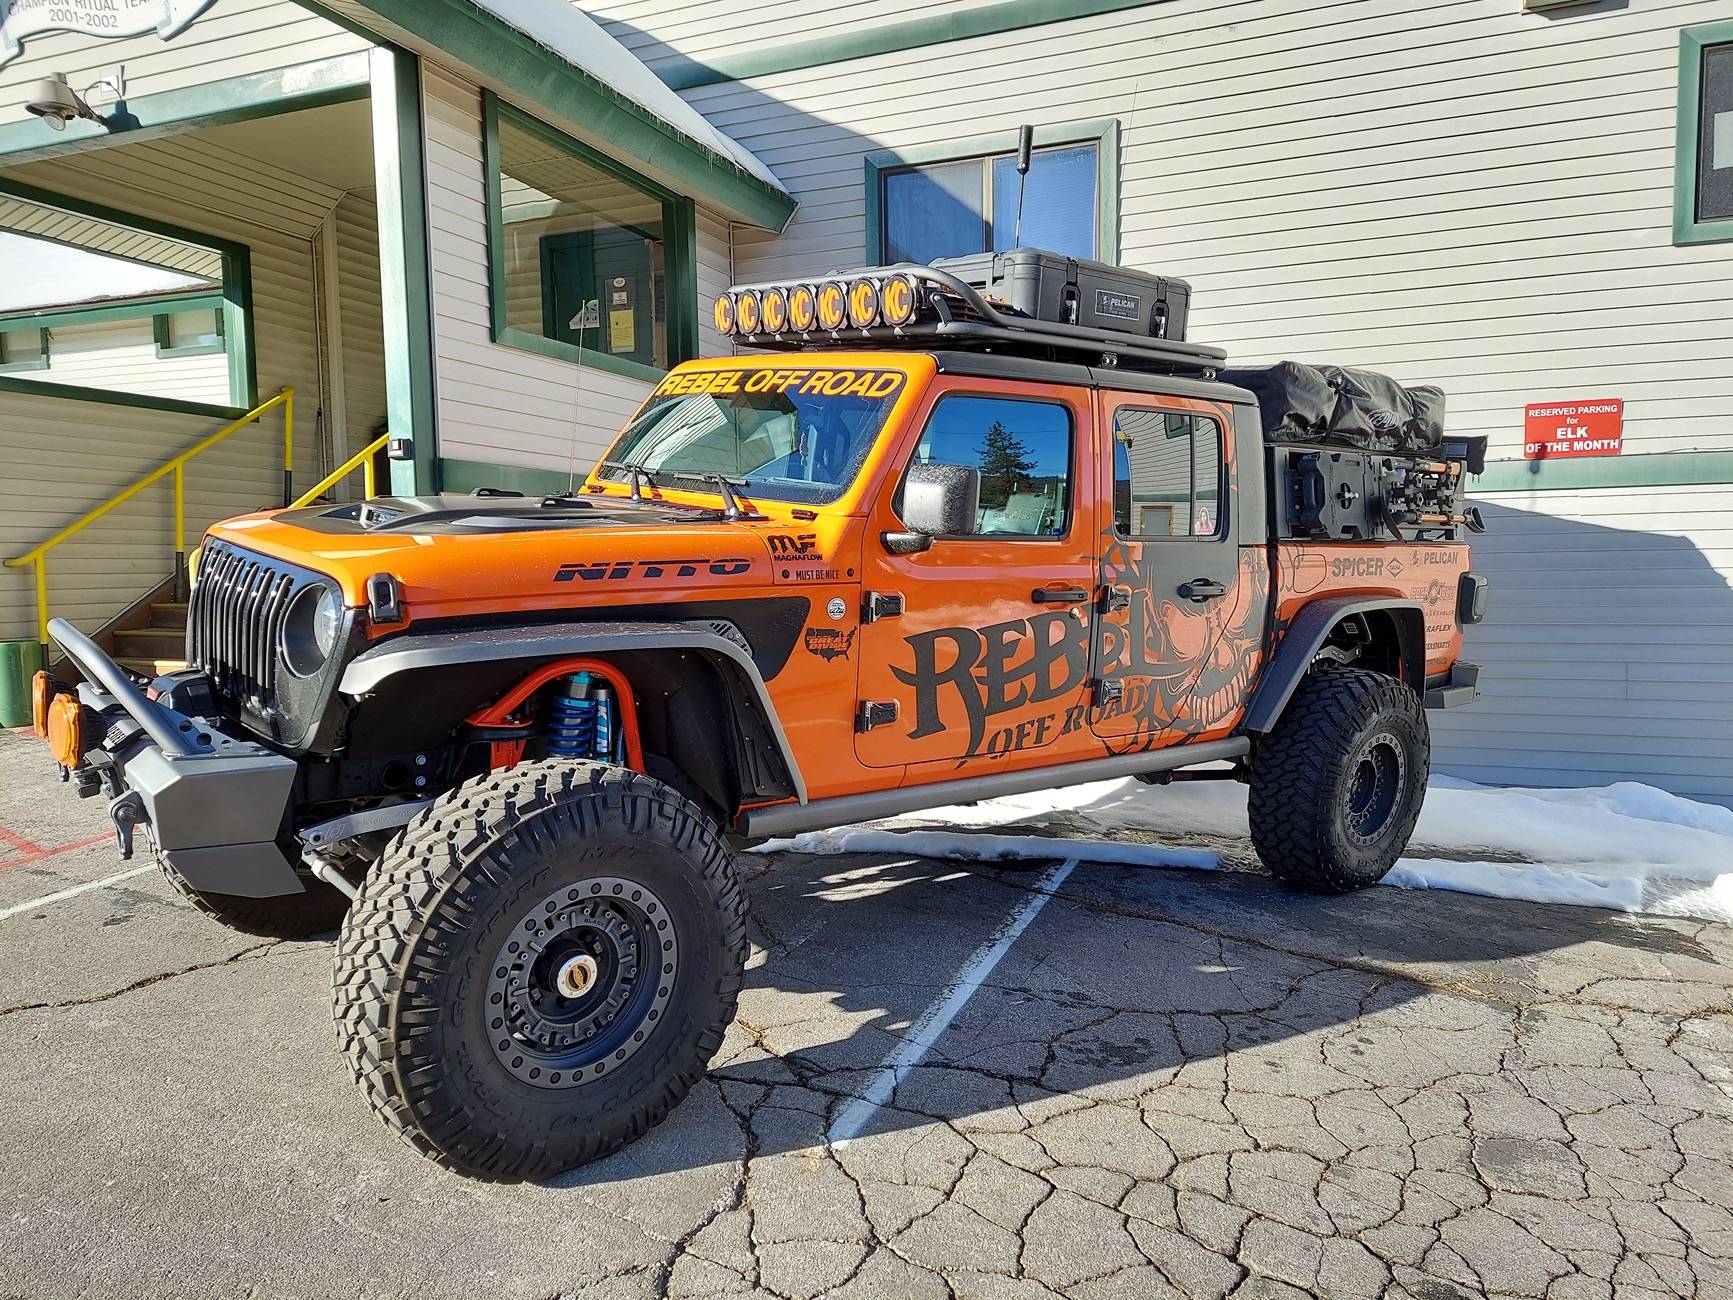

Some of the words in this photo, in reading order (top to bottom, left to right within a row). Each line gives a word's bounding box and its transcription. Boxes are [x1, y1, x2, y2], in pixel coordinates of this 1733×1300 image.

[49, 8, 118, 28] 2001-2002
[714, 296, 730, 331] KC
[738, 294, 755, 330] KC
[763, 292, 781, 329] KC
[790, 290, 809, 327] KC
[820, 287, 840, 325] KC
[851, 283, 873, 323] KC
[884, 280, 908, 321] KC
[655, 371, 743, 396] REBEL
[744, 369, 809, 394] OFF
[799, 370, 903, 397] ROAD
[1528, 407, 1576, 417] RESERVED
[1578, 404, 1618, 414] PARKING
[1566, 416, 1580, 425] for
[1525, 443, 1541, 453] OF
[1545, 442, 1570, 452] THE
[1573, 439, 1619, 451] MONTH
[1556, 426, 1589, 439] ELK
[552, 558, 751, 582] NITTO
[1331, 557, 1384, 577] SPICER
[1424, 551, 1458, 565] PELICAN
[795, 569, 814, 580] MUST
[815, 569, 824, 580] BE
[825, 569, 840, 579] NICE
[1425, 624, 1452, 633] RAFLEX
[889, 600, 1192, 769] REBEL
[597, 705, 608, 753] KIN
[986, 713, 1056, 759] OFF
[1062, 685, 1146, 735] ROAD
